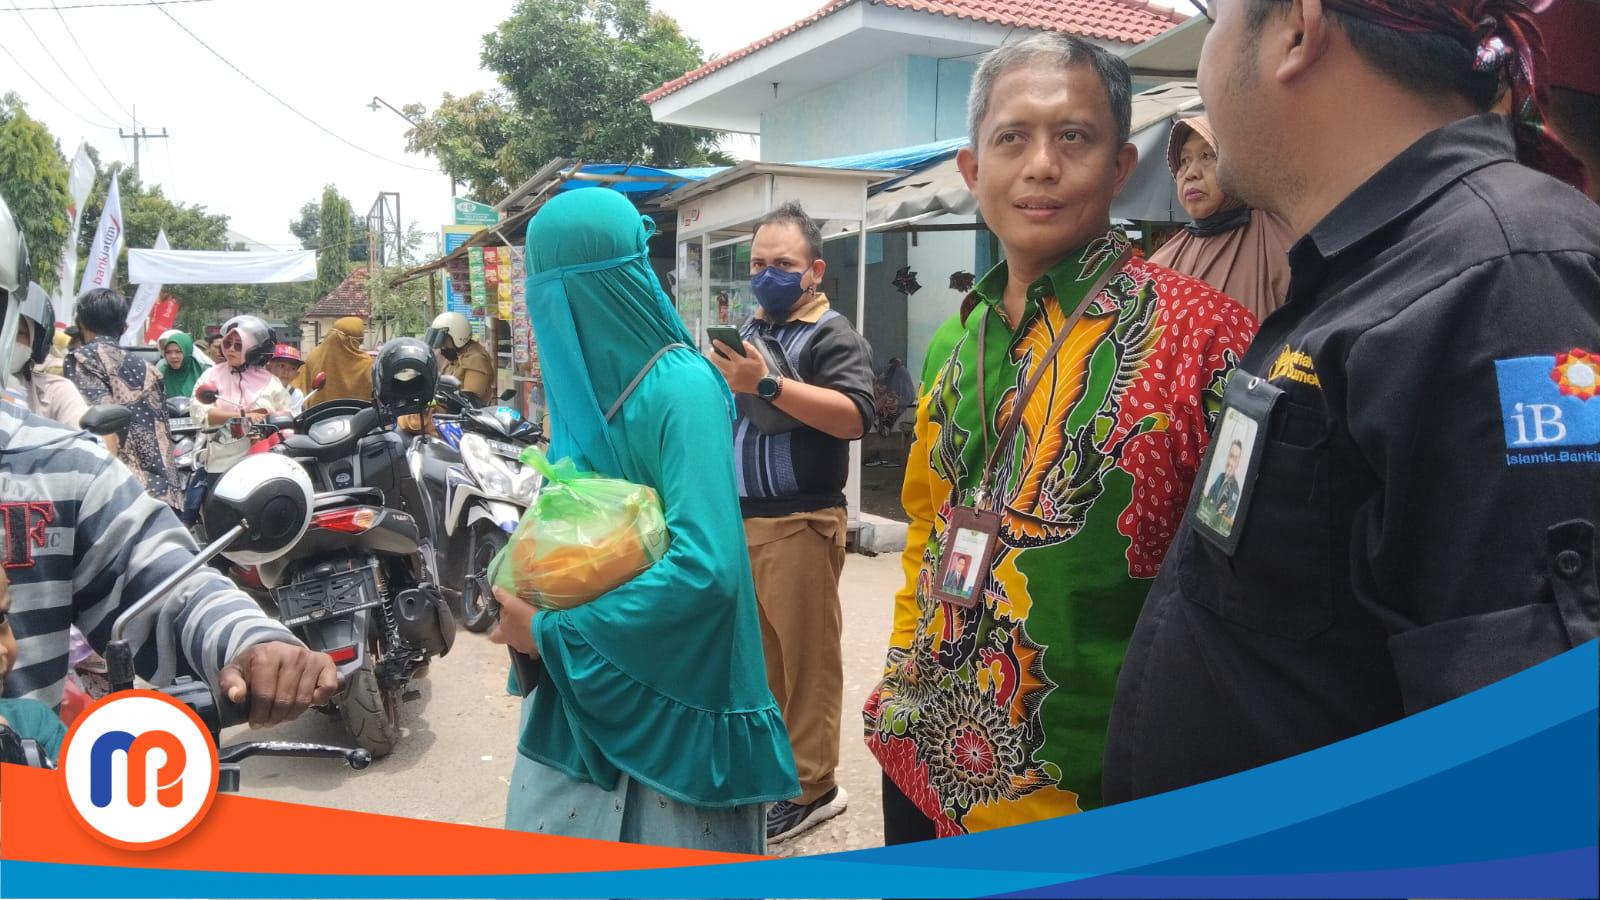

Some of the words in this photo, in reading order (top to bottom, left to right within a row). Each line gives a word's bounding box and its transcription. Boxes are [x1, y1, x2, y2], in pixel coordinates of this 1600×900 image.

[92, 226, 118, 286] bankjatim
[1510, 401, 1567, 445] iB
[1505, 452, 1556, 467] Islamic
